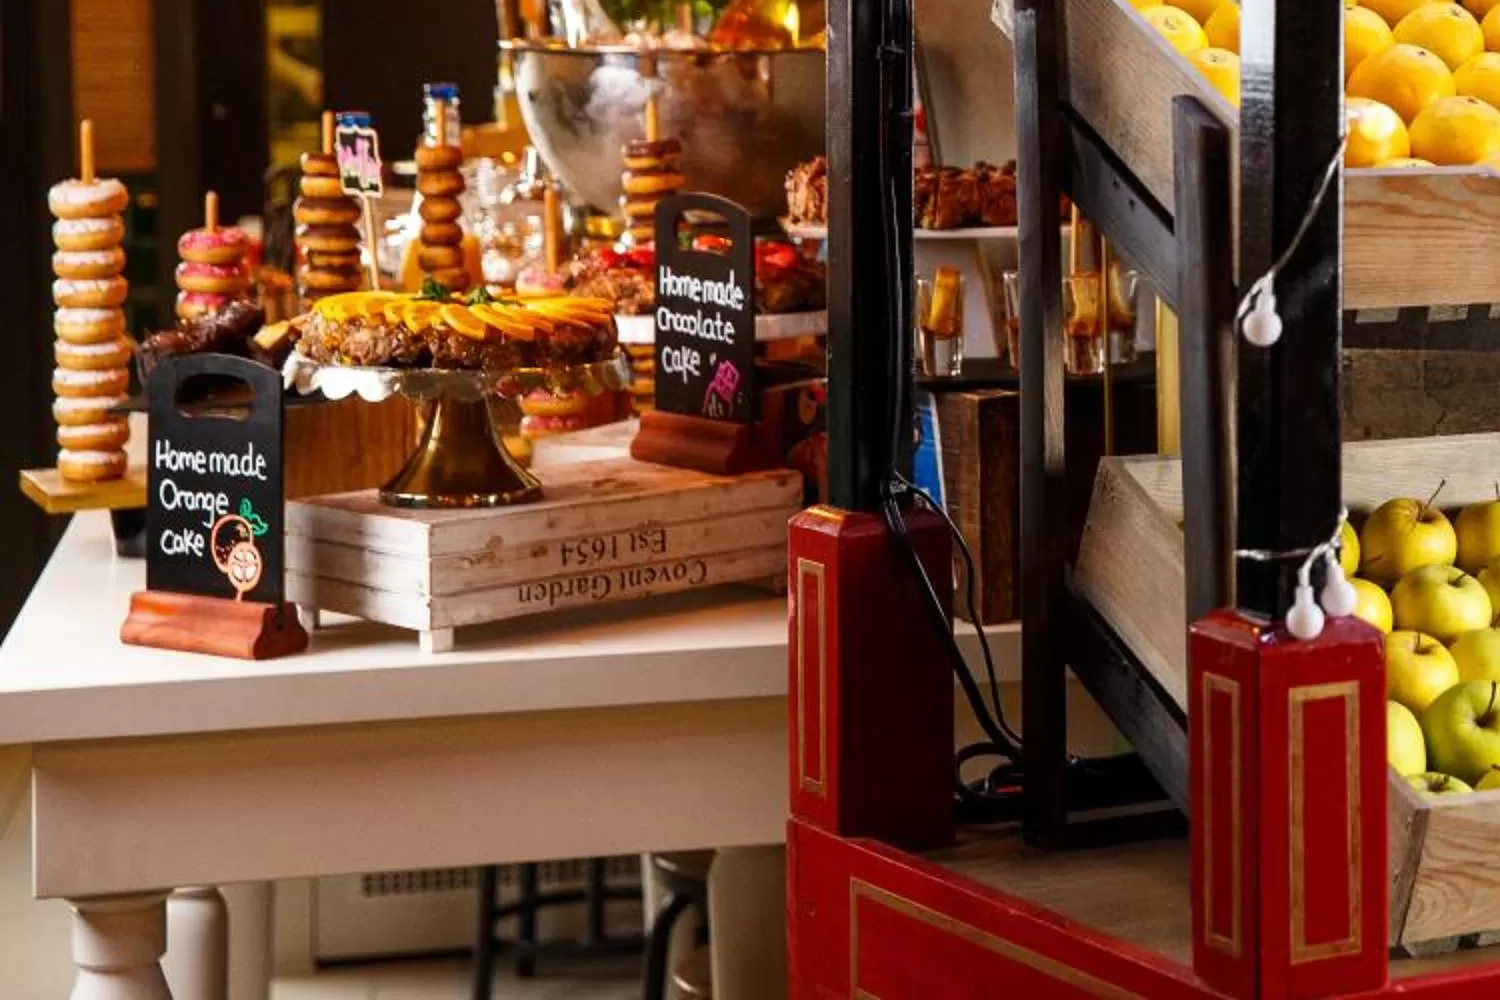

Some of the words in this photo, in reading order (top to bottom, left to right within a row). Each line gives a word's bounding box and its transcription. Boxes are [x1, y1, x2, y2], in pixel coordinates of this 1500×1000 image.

[159, 478, 230, 529] Orange
[560, 534, 618, 567] 1654
[629, 529, 668, 553] Est
[619, 560, 708, 586] Covent
[518, 574, 612, 606] Garden
